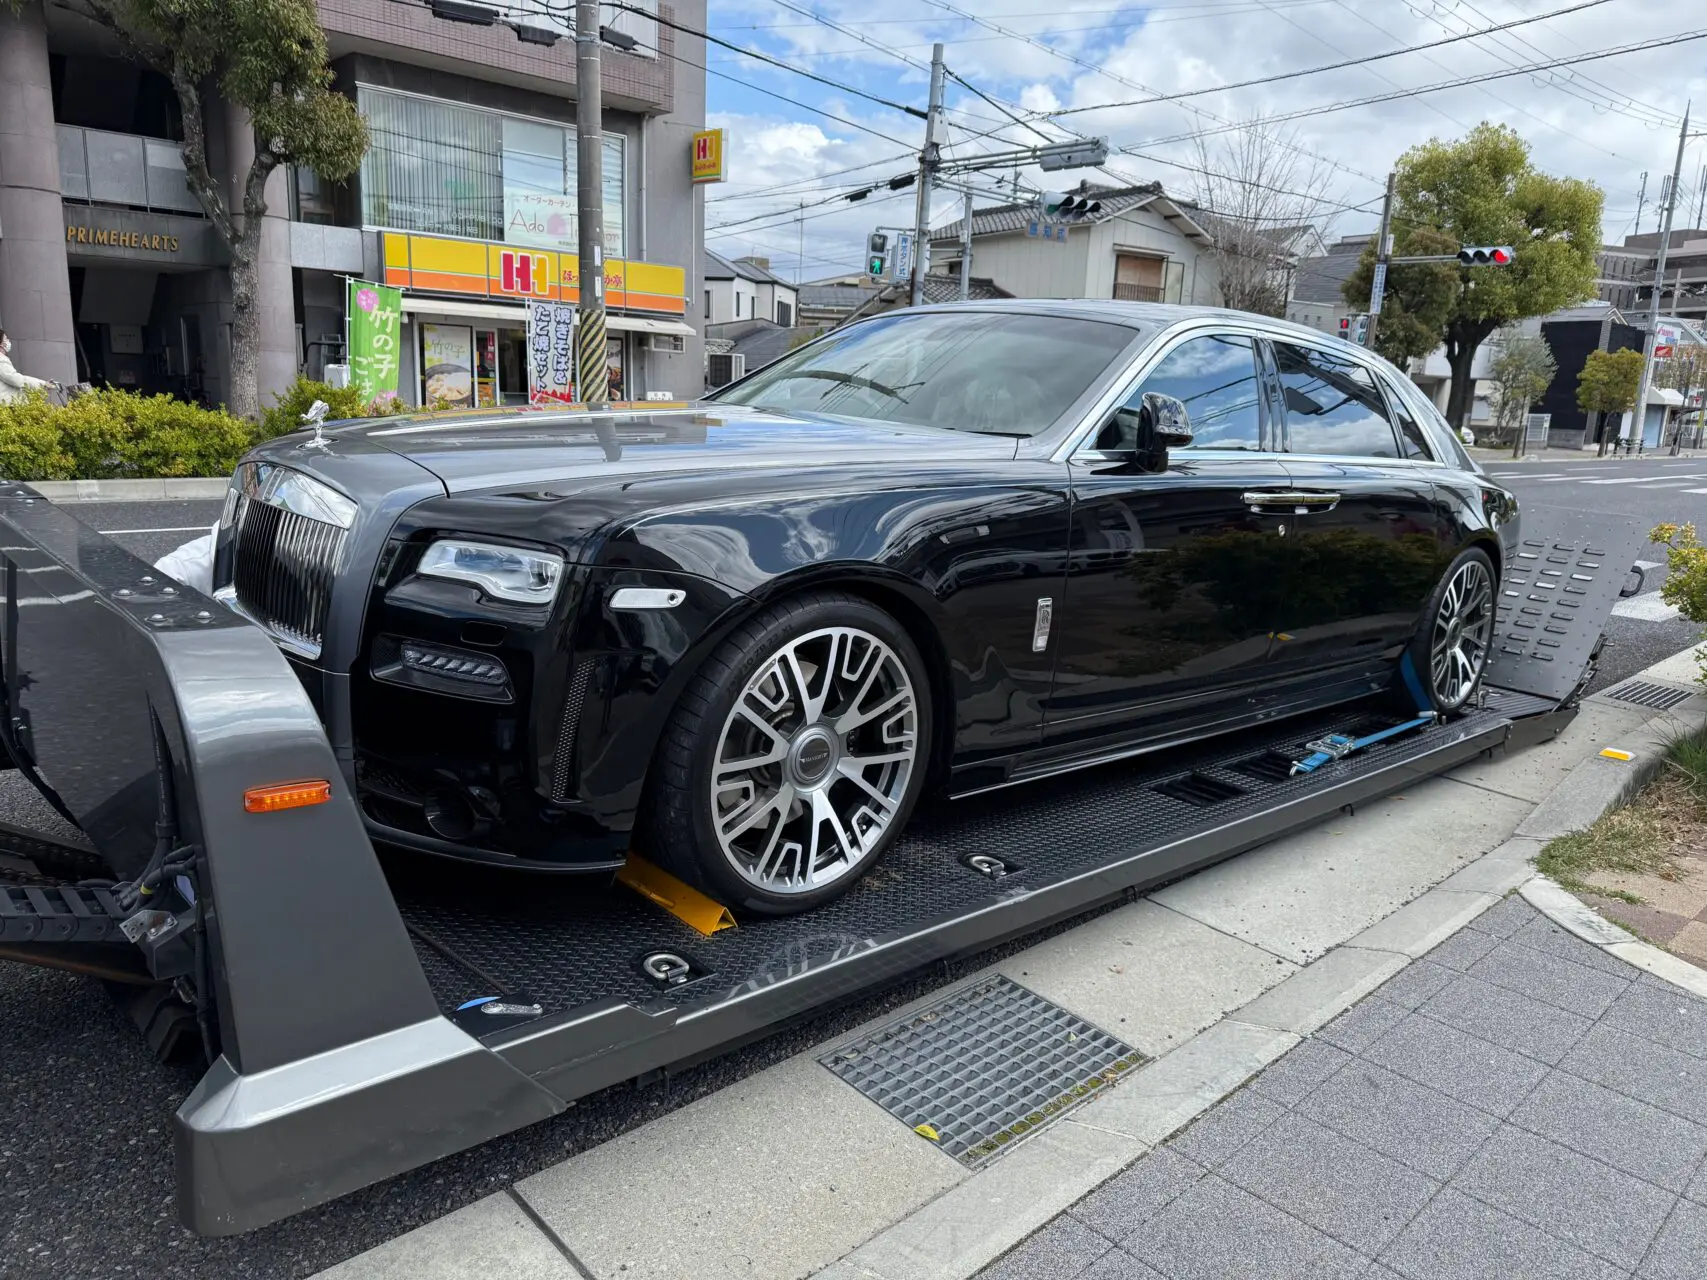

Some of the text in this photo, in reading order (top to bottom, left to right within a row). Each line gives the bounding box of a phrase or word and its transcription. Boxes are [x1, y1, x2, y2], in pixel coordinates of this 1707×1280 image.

[66, 224, 180, 252] PRIMEHEARTS
[508, 208, 545, 233] Ado
[368, 304, 399, 380] 竹の子
[431, 338, 466, 359] 竹の子
[532, 304, 551, 393] たこ焼セット
[551, 306, 572, 385] 焼きそば&
[355, 355, 374, 400] ごは
